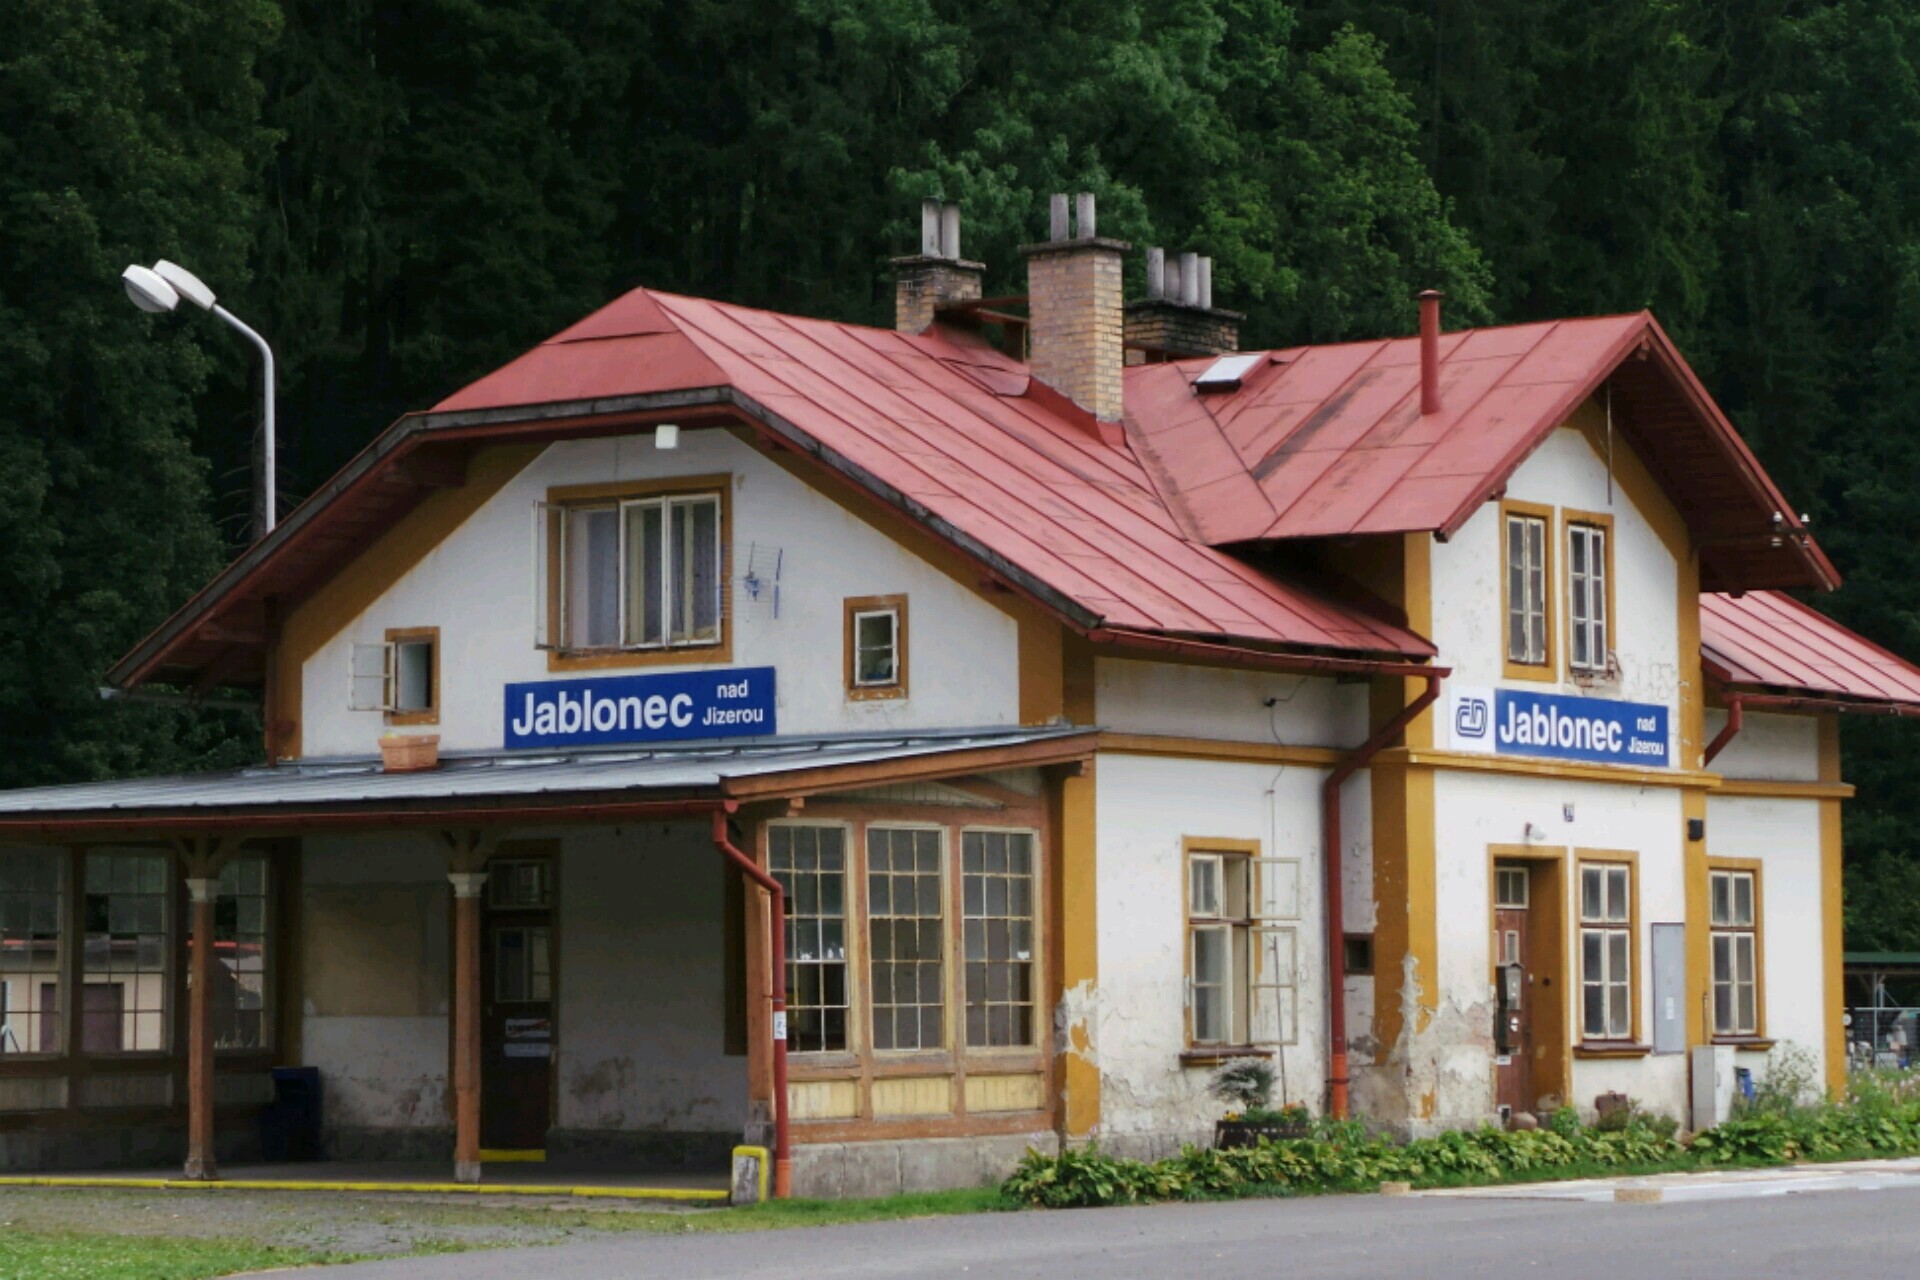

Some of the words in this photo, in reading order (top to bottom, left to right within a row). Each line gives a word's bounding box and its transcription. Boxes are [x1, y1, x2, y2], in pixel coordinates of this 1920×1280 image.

[717, 679, 748, 698] nad
[513, 689, 693, 736] Jablonec
[702, 707, 764, 726] Jizerou
[1500, 700, 1623, 752] Jablonec
[1637, 716, 1656, 732] nad
[1628, 736, 1664, 756] Jizerou
